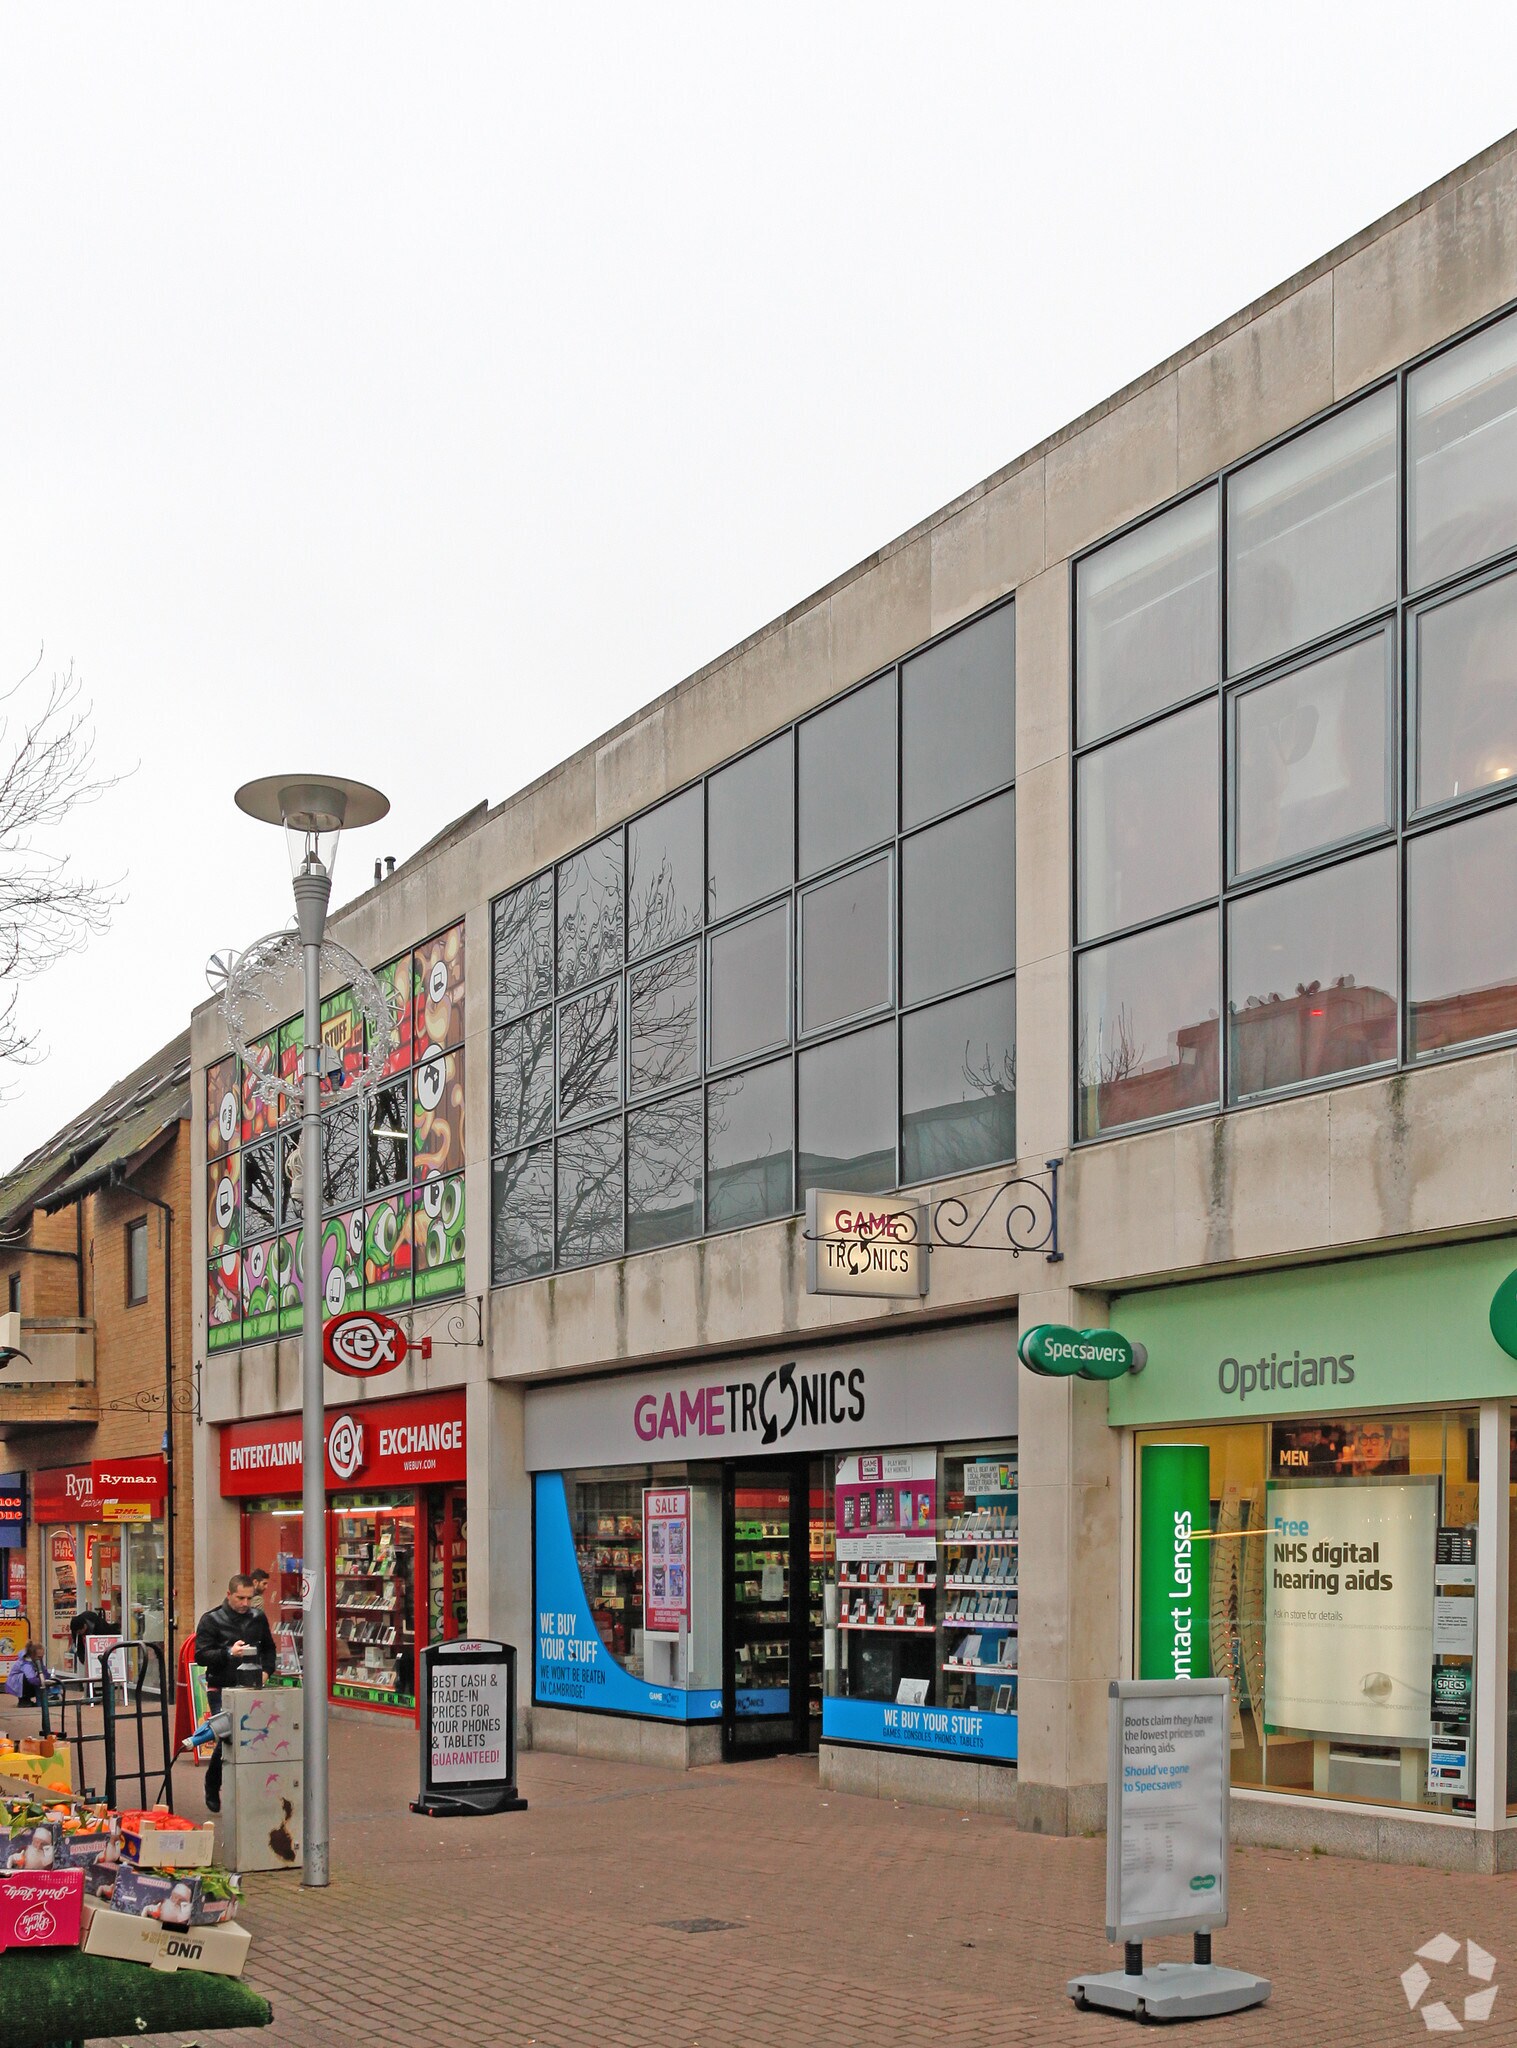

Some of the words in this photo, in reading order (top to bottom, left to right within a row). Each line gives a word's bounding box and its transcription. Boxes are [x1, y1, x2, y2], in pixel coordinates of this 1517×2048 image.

[325, 1019, 348, 1047] STUFF
[834, 1209, 899, 1239] GAME
[1044, 1337, 1126, 1363] Specsavers
[1218, 1350, 1355, 1401] Opticians
[379, 1420, 463, 1457] EXCHANGE
[230, 1439, 326, 1471] ENTERTAINM
[1279, 1449, 1309, 1467] MEN
[403, 1458, 436, 1471] WEBUY.COM
[99, 1474, 158, 1485] Ryman
[114, 1507, 139, 1515] DHL
[655, 1497, 678, 1514] SALE
[1274, 1516, 1309, 1537] Free
[54, 1548, 74, 1557] PRIC
[1167, 1510, 1192, 1600] Lenses
[1273, 1542, 1308, 1563] NHS
[1312, 1541, 1379, 1569] digital
[1273, 1568, 1340, 1596] hearing
[1344, 1569, 1393, 1592] aids
[1290, 1609, 1307, 1620] store
[1307, 1610, 1318, 1620] for
[1319, 1610, 1343, 1621] details
[540, 1612, 555, 1635] WE
[557, 1613, 576, 1636] BUY
[459, 1643, 482, 1652] GAME
[540, 1637, 565, 1661] YOUR
[567, 1638, 598, 1664] STUFF
[432, 1675, 458, 1689] BEST
[461, 1673, 487, 1688] CASH
[489, 1673, 498, 1687] &
[540, 1665, 549, 1679] WE
[572, 1667, 580, 1682] BE
[581, 1668, 606, 1685] BEATEN
[540, 1681, 547, 1694] IN
[1437, 1679, 1465, 1690] SPECS
[432, 1689, 479, 1703] TRADE-IN
[432, 1705, 467, 1719] PRICES
[470, 1704, 490, 1718] FOR
[432, 1720, 459, 1734] YOUR
[462, 1718, 501, 1733] PHONES
[883, 1708, 898, 1727] WE
[901, 1710, 920, 1730] BUY
[922, 1712, 948, 1733] YOUR
[951, 1715, 983, 1736] STUFF
[1124, 1716, 1150, 1727] Boots
[1150, 1715, 1172, 1726] claim
[1173, 1714, 1193, 1727] they
[1193, 1714, 1214, 1724] have
[432, 1736, 440, 1750] &
[443, 1734, 486, 1749] TABLETS
[960, 1735, 984, 1749] TABLETS
[1124, 1730, 1139, 1741] the
[1140, 1729, 1168, 1740] lowest
[1169, 1728, 1194, 1741] prices
[1194, 1729, 1205, 1738] on
[1124, 1743, 1157, 1756] hearing
[1158, 1742, 1176, 1753] aids
[432, 1750, 500, 1767] GUARANTEED!
[1124, 1764, 1168, 1777] Should've
[1169, 1764, 1190, 1776] gone
[1124, 1782, 1133, 1792] to
[1135, 1780, 1182, 1793] Specsavers
[2, 1884, 37, 1900] Lady
[37, 1886, 77, 1900] Pink
[20, 1910, 46, 1926] Lady
[25, 1917, 52, 1936] Pink
[167, 1941, 203, 1960] UNO
